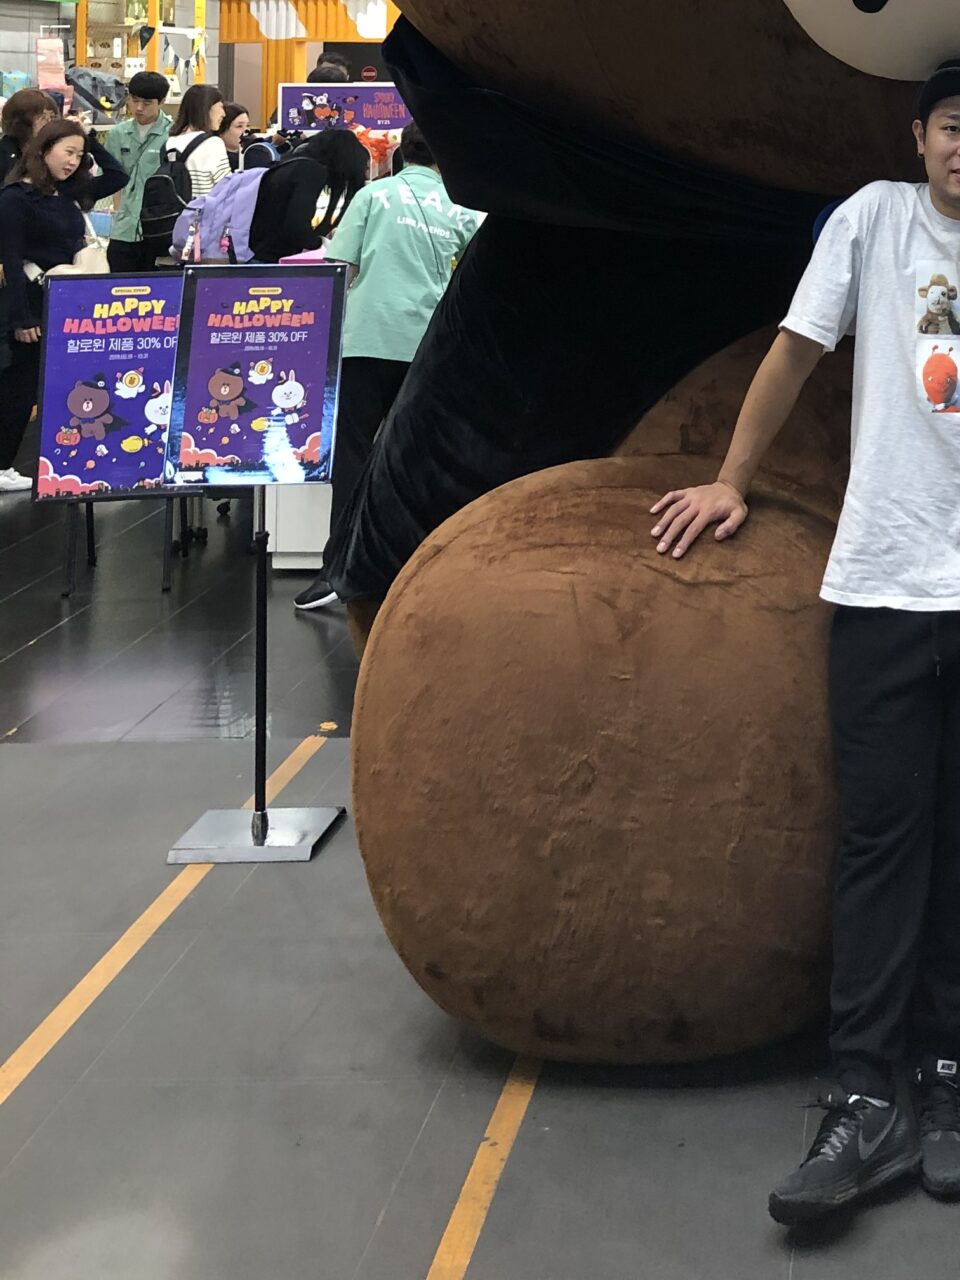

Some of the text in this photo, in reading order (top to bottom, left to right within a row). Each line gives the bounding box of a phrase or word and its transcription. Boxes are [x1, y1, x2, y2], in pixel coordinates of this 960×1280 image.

[372, 183, 473, 231] TEAM
[93, 297, 166, 319] HAPPY
[232, 297, 294, 315] HAPPY
[63, 314, 180, 334] HALLOWEE
[207, 311, 315, 329] HALLOWEEN
[67, 336, 178, 353] 할로윈 제품 30% OF
[210, 331, 309, 344] 할로윈 제품 30% OFF
